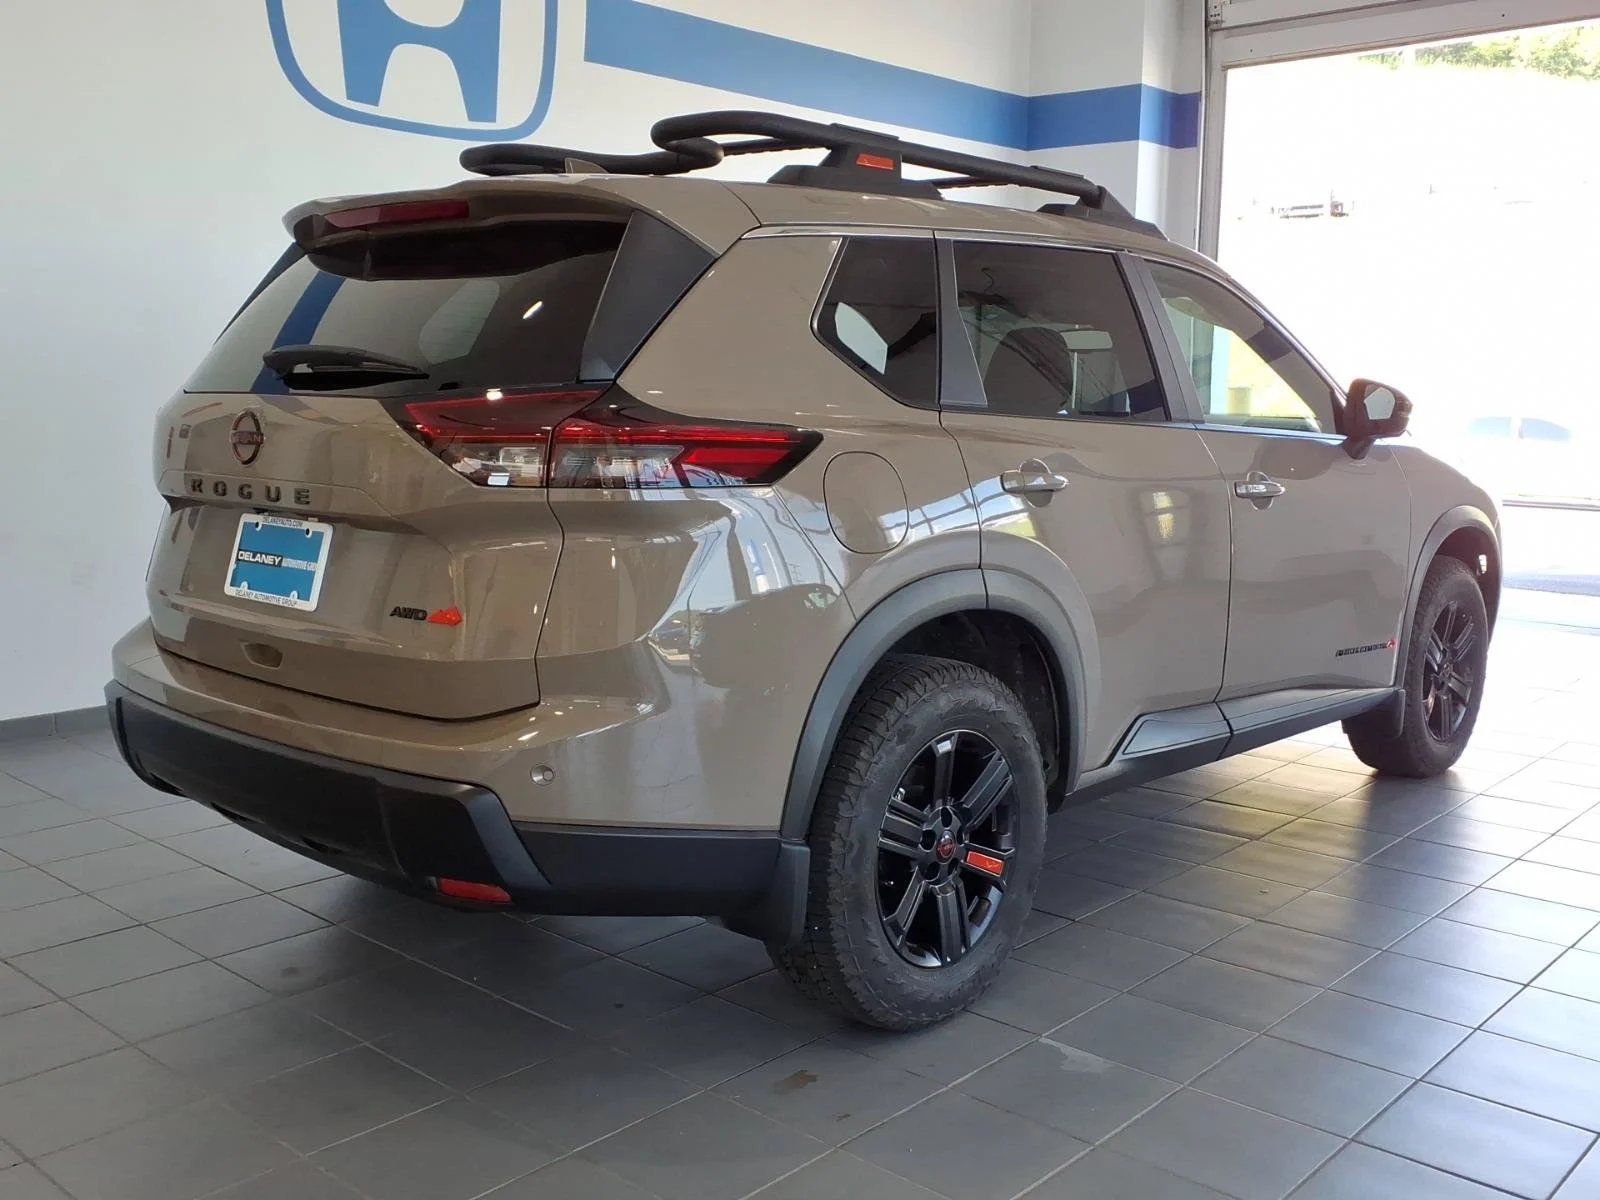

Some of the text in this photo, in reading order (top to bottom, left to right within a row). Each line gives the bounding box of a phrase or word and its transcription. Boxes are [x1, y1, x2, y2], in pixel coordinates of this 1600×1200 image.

[190, 477, 312, 506] ROGUE
[238, 551, 282, 566] DELANEY
[254, 593, 280, 605] AUTOMOTIVE
[281, 598, 298, 607] GROUP
[389, 606, 428, 621] AWD
